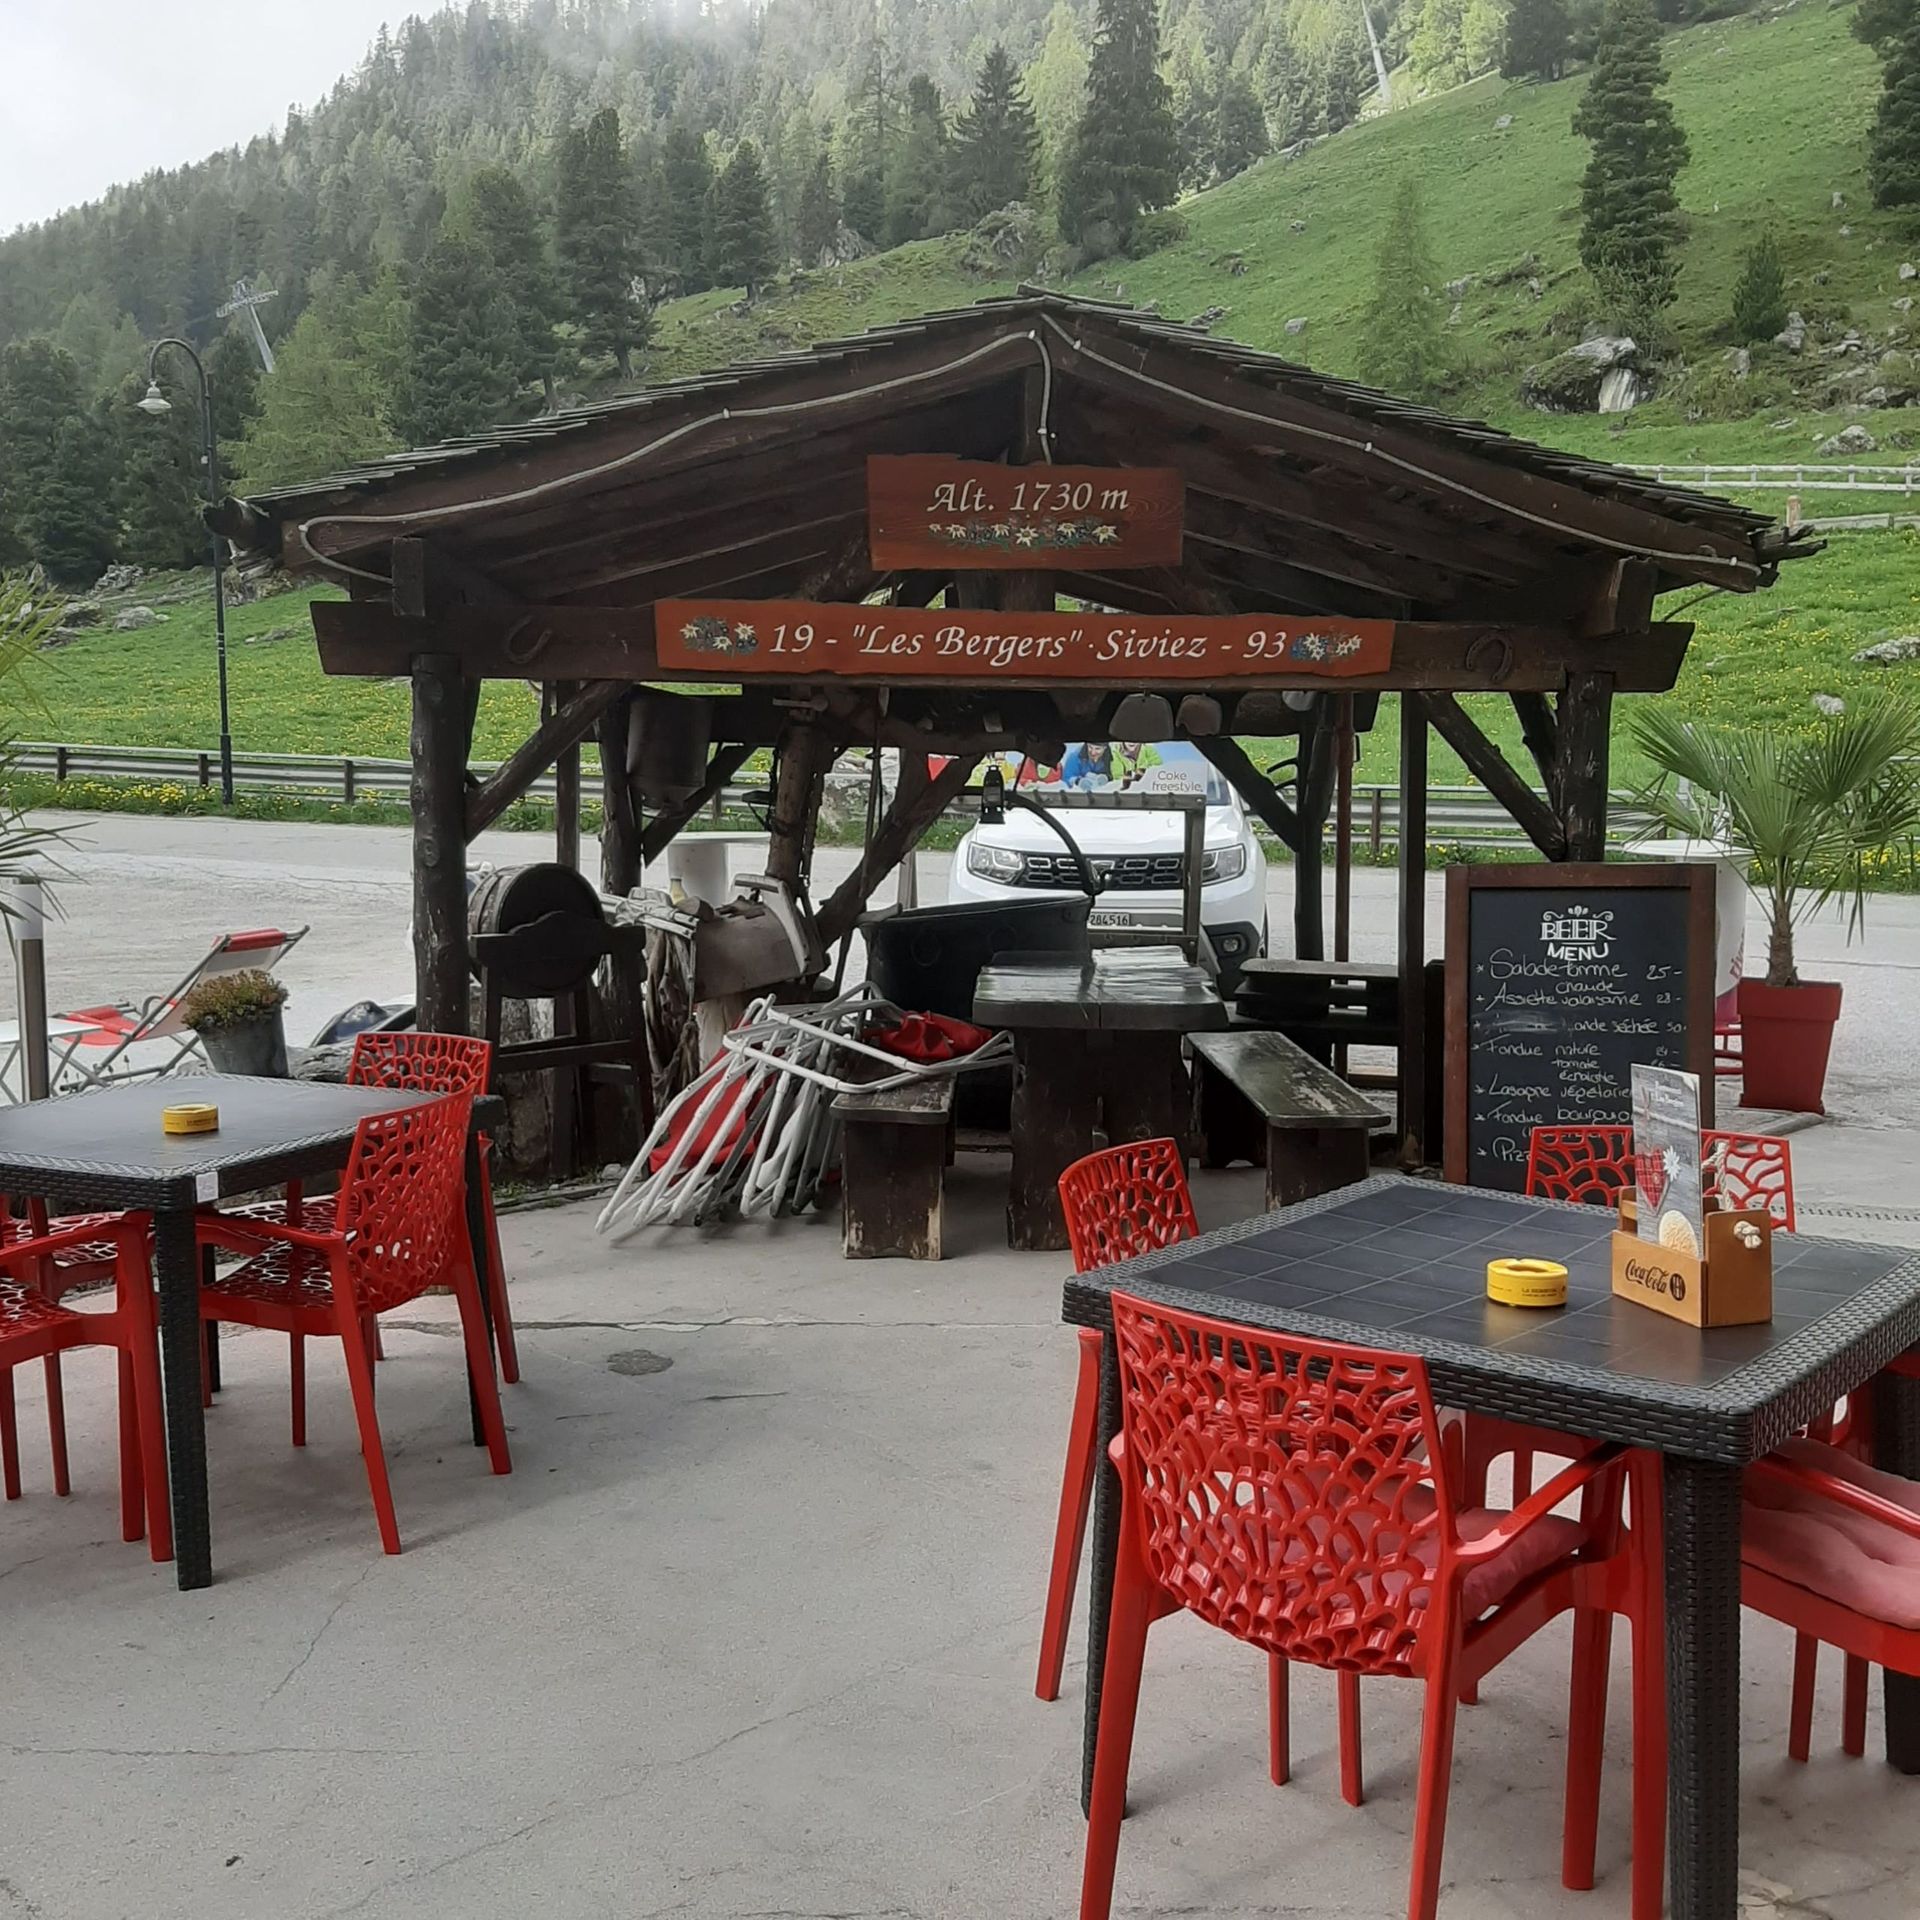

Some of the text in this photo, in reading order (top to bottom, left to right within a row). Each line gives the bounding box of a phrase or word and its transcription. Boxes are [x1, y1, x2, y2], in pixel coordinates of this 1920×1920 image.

[927, 479, 1129, 512] Alt. 1730 m
[769, 624, 814, 653] 19
[853, 624, 923, 655] "Les
[935, 626, 1083, 667] Bergers"
[1096, 629, 1208, 661] Siviez
[1243, 631, 1287, 659] 93
[1157, 770, 1187, 781] Coke
[1540, 919, 1616, 940] BEER
[1489, 948, 1560, 979] Salade
[1547, 942, 1609, 961] MENU
[1485, 982, 1557, 1011] Assiette
[1555, 980, 1625, 995] chaude
[1480, 1034, 1543, 1056] Fondue
[1555, 1043, 1602, 1056] nature
[1551, 1057, 1600, 1069] tomate
[1489, 1073, 1552, 1102] Lasagne
[1561, 1084, 1632, 1104] végétarie
[1487, 1100, 1543, 1124] Fondue
[1492, 1137, 1531, 1162] Pizz
